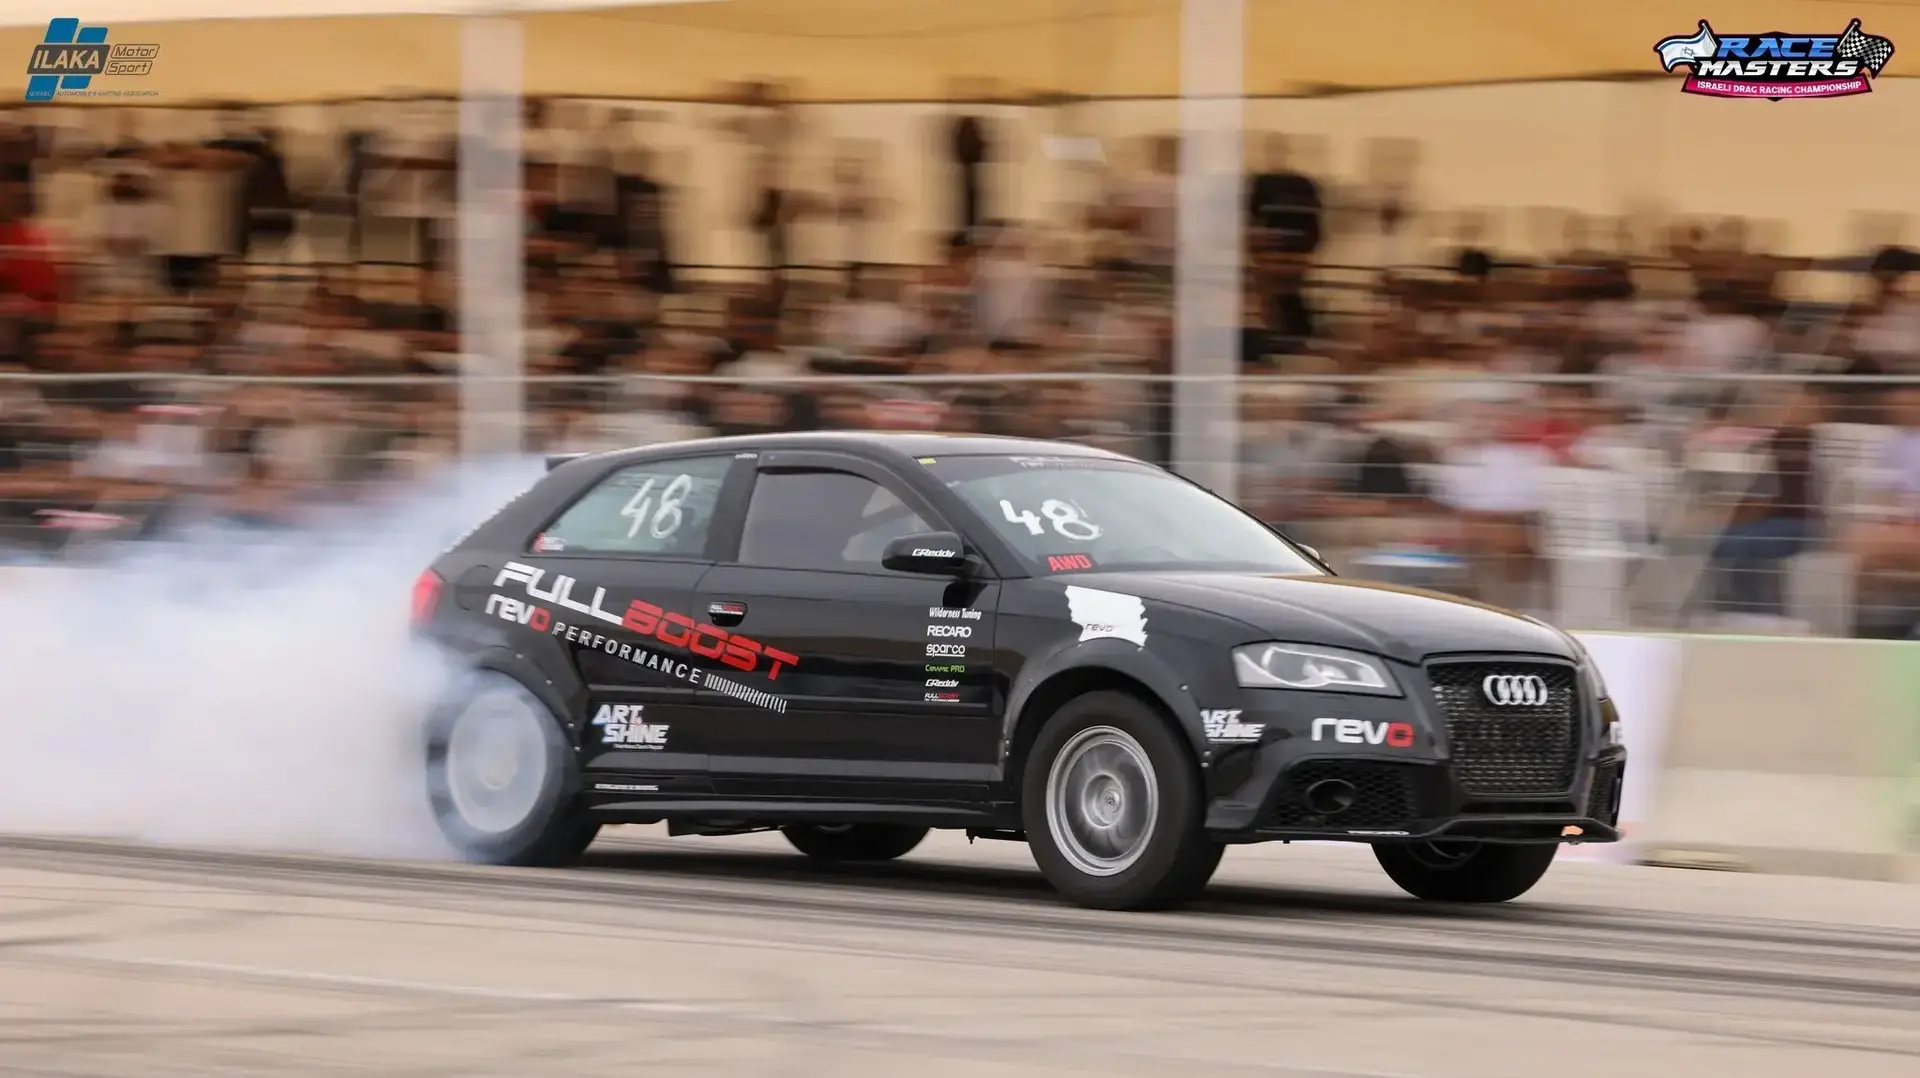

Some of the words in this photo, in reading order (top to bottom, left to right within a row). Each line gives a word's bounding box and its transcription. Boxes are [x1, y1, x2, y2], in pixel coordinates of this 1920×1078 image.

[621, 474, 693, 539] 48
[999, 499, 1103, 541] 48
[912, 548, 956, 557] GReddy
[1047, 554, 1092, 571] AWD
[929, 606, 961, 618] Wilderness
[961, 607, 982, 620] Tuning
[926, 625, 972, 638] RECARO
[1085, 623, 1114, 632] revo
[485, 593, 552, 632] revo
[552, 621, 702, 685] PERFORMANCE
[926, 643, 966, 657] sparco
[950, 664, 965, 673] PRO
[925, 679, 959, 687] GReddy
[591, 704, 644, 725] ART
[601, 723, 670, 744] SHINE
[1311, 717, 1415, 748] revo
